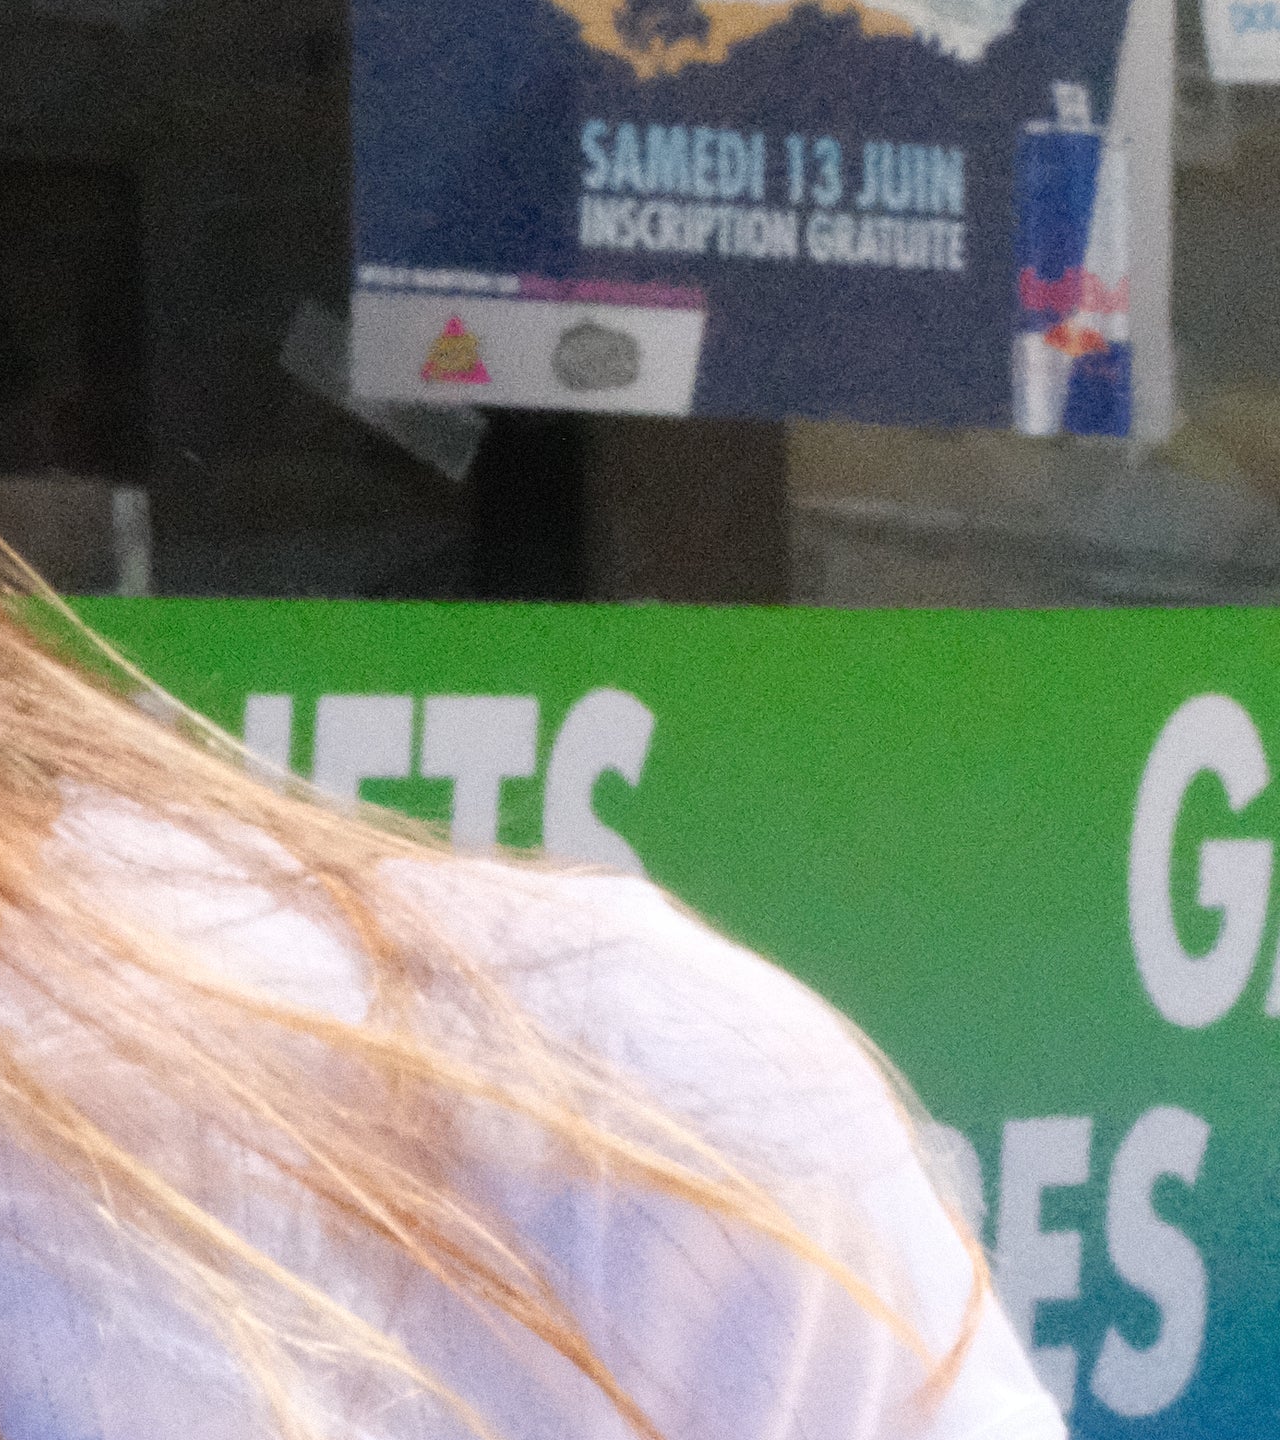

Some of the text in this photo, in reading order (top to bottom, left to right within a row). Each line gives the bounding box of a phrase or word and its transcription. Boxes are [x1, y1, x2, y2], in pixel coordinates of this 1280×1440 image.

[580, 118, 964, 216] SAMEDI 13 JUIN
[579, 193, 965, 272] INSCRIPTION GRATUITE
